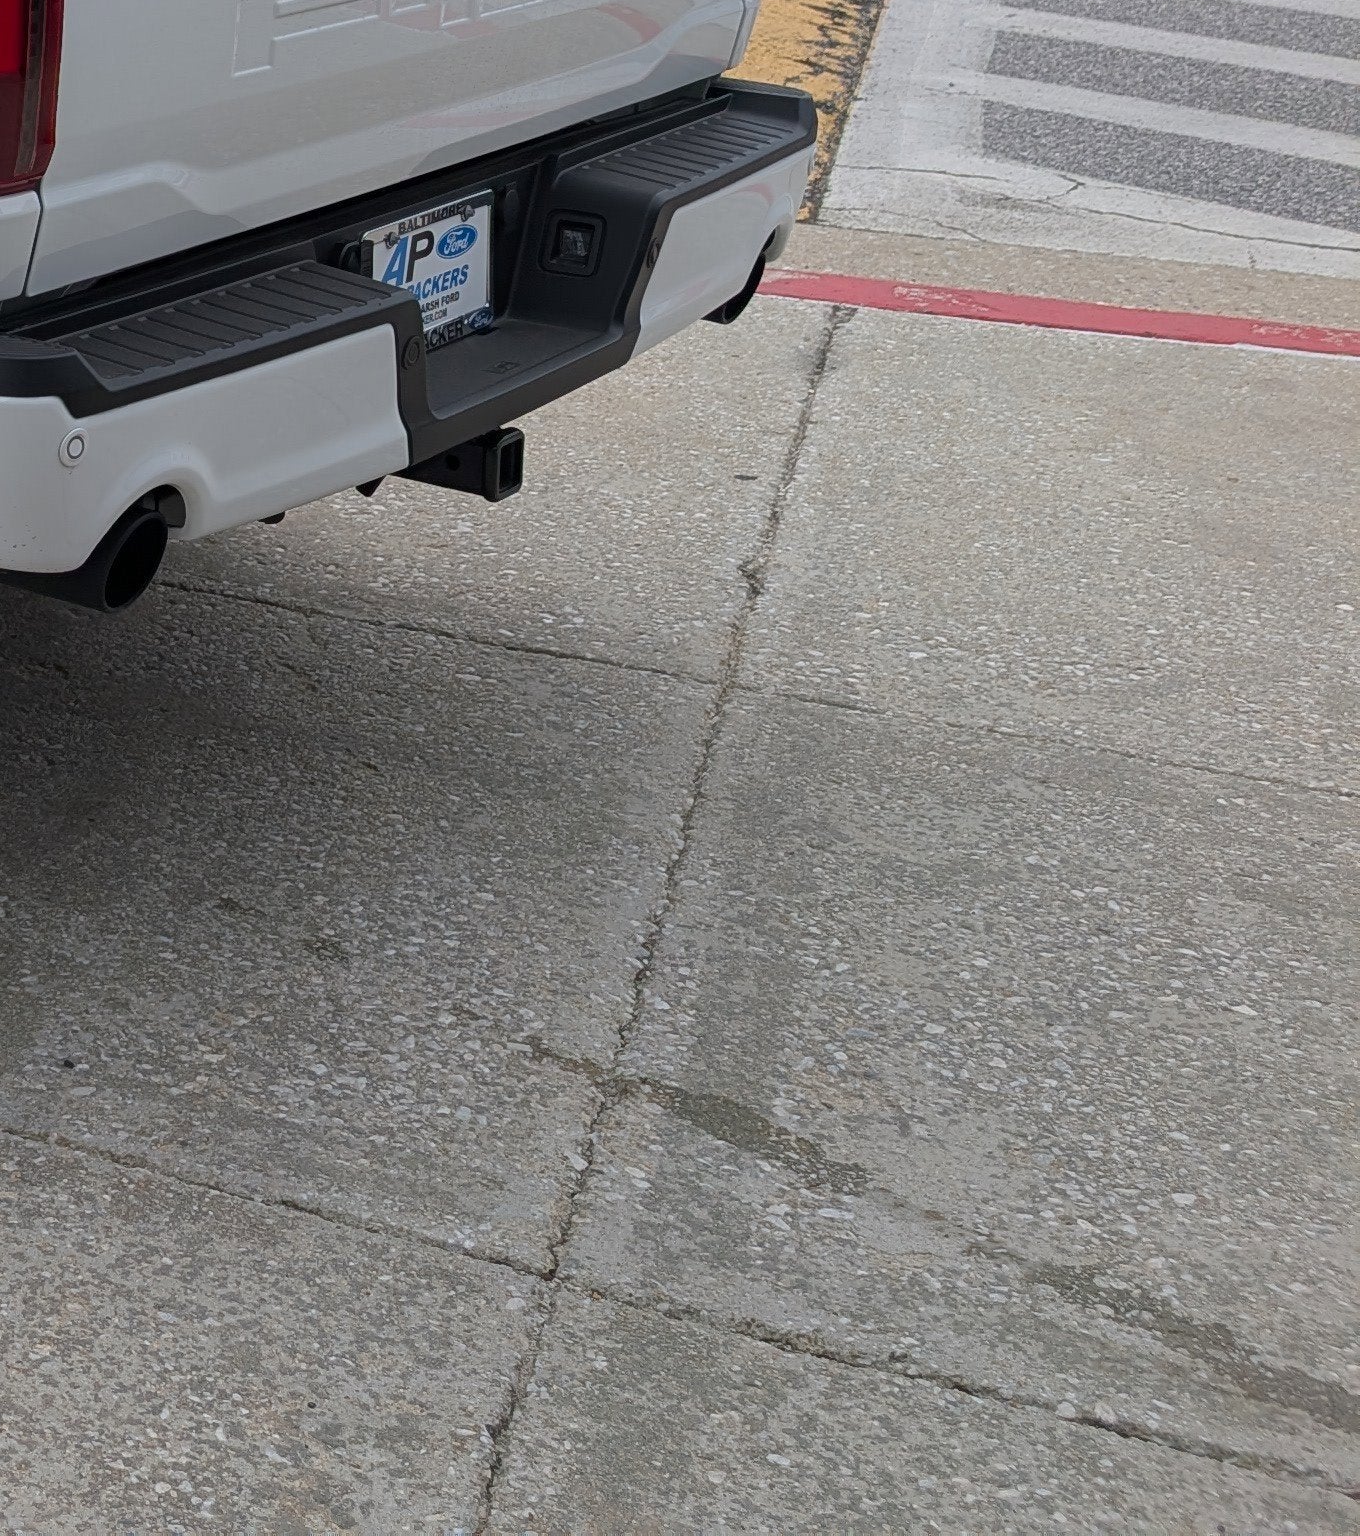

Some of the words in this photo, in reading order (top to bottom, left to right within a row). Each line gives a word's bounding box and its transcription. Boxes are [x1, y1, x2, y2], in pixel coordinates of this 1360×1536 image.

[443, 230, 470, 254] Ford
[420, 299, 440, 314] ARSH
[441, 291, 460, 306] FORD
